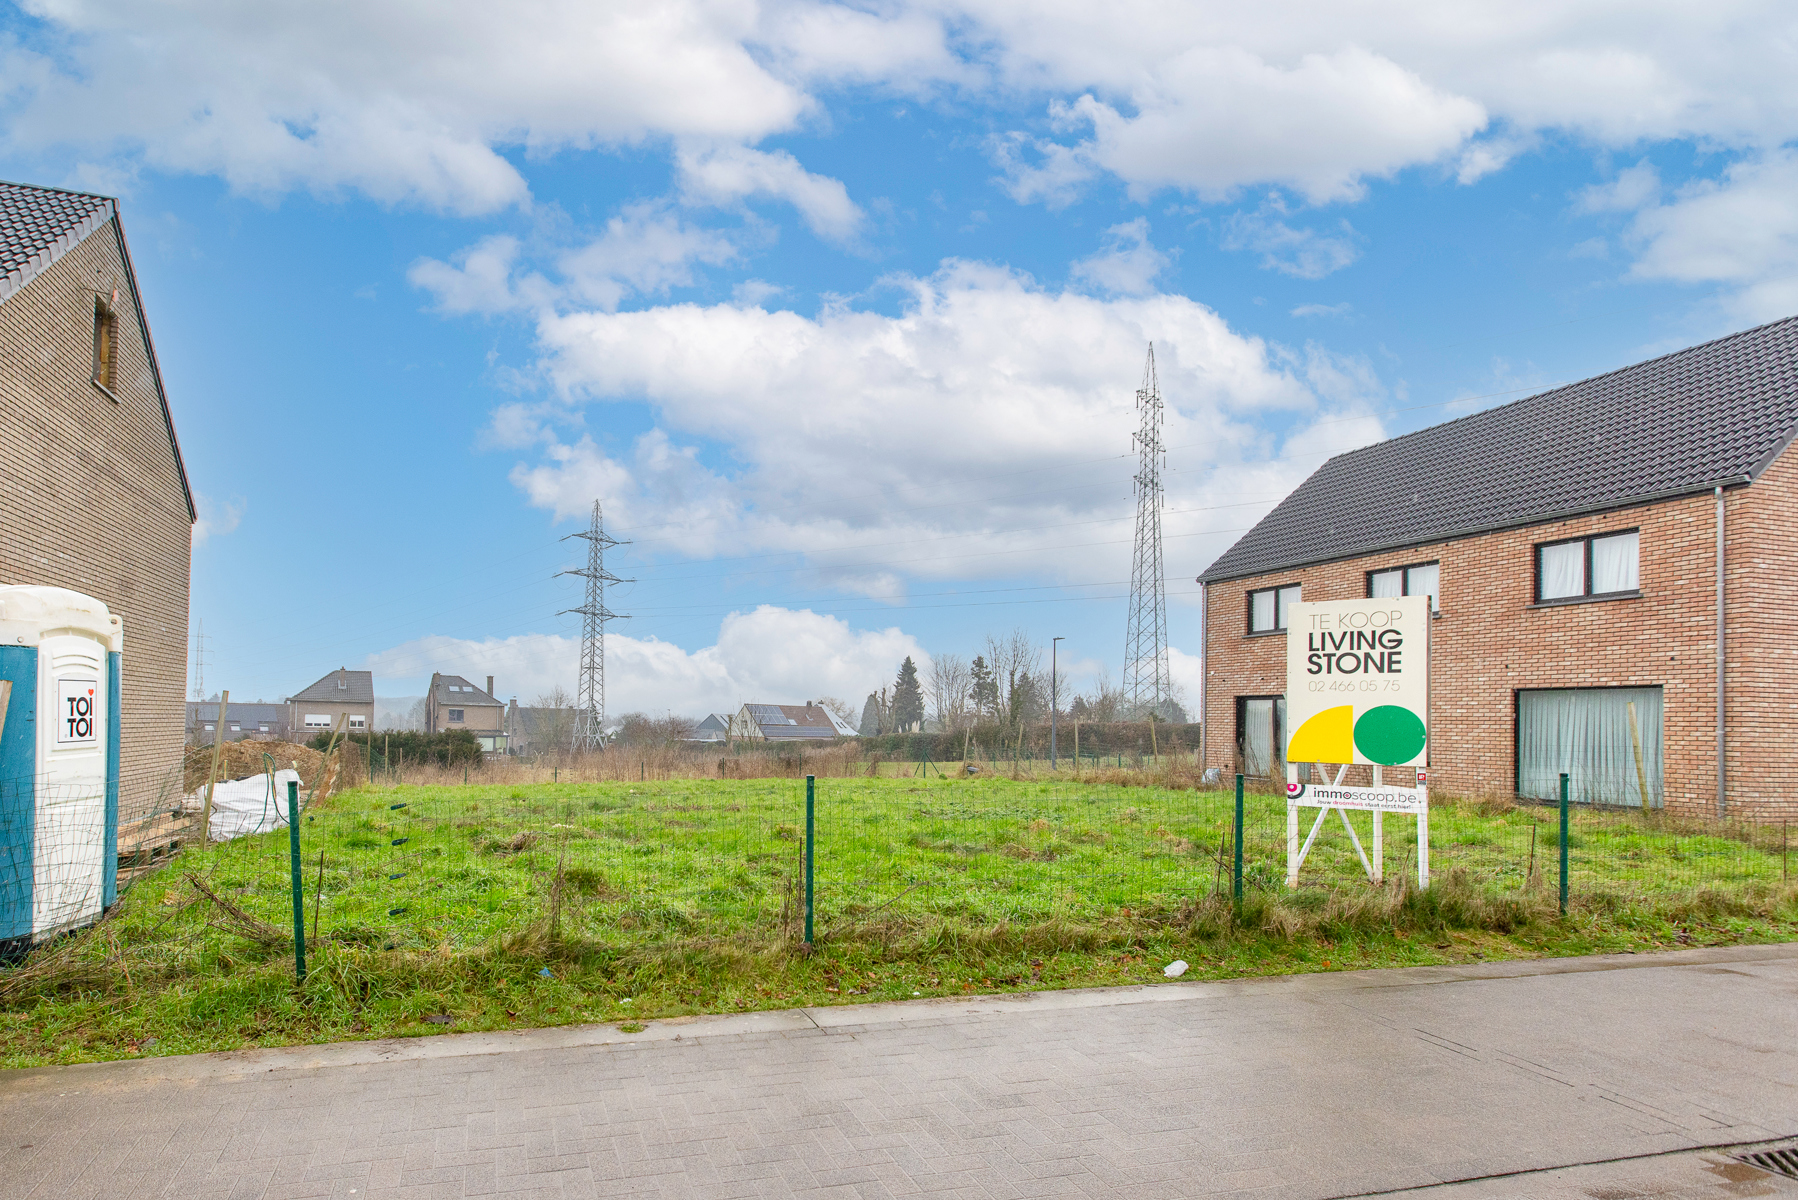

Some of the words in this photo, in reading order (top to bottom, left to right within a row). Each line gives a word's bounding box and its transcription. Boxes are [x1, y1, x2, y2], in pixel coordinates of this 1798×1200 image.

[1308, 613, 1330, 630] TE
[1339, 610, 1403, 629] KOOP
[1308, 629, 1403, 652] LIVING
[1307, 651, 1402, 675] STONE
[1308, 680, 1325, 692] 02
[1329, 680, 1355, 692] 466
[1359, 680, 1377, 692] 05
[1383, 679, 1401, 692] 75
[67, 717, 93, 738] TOI
[1313, 787, 1417, 804] immoscoop.be
